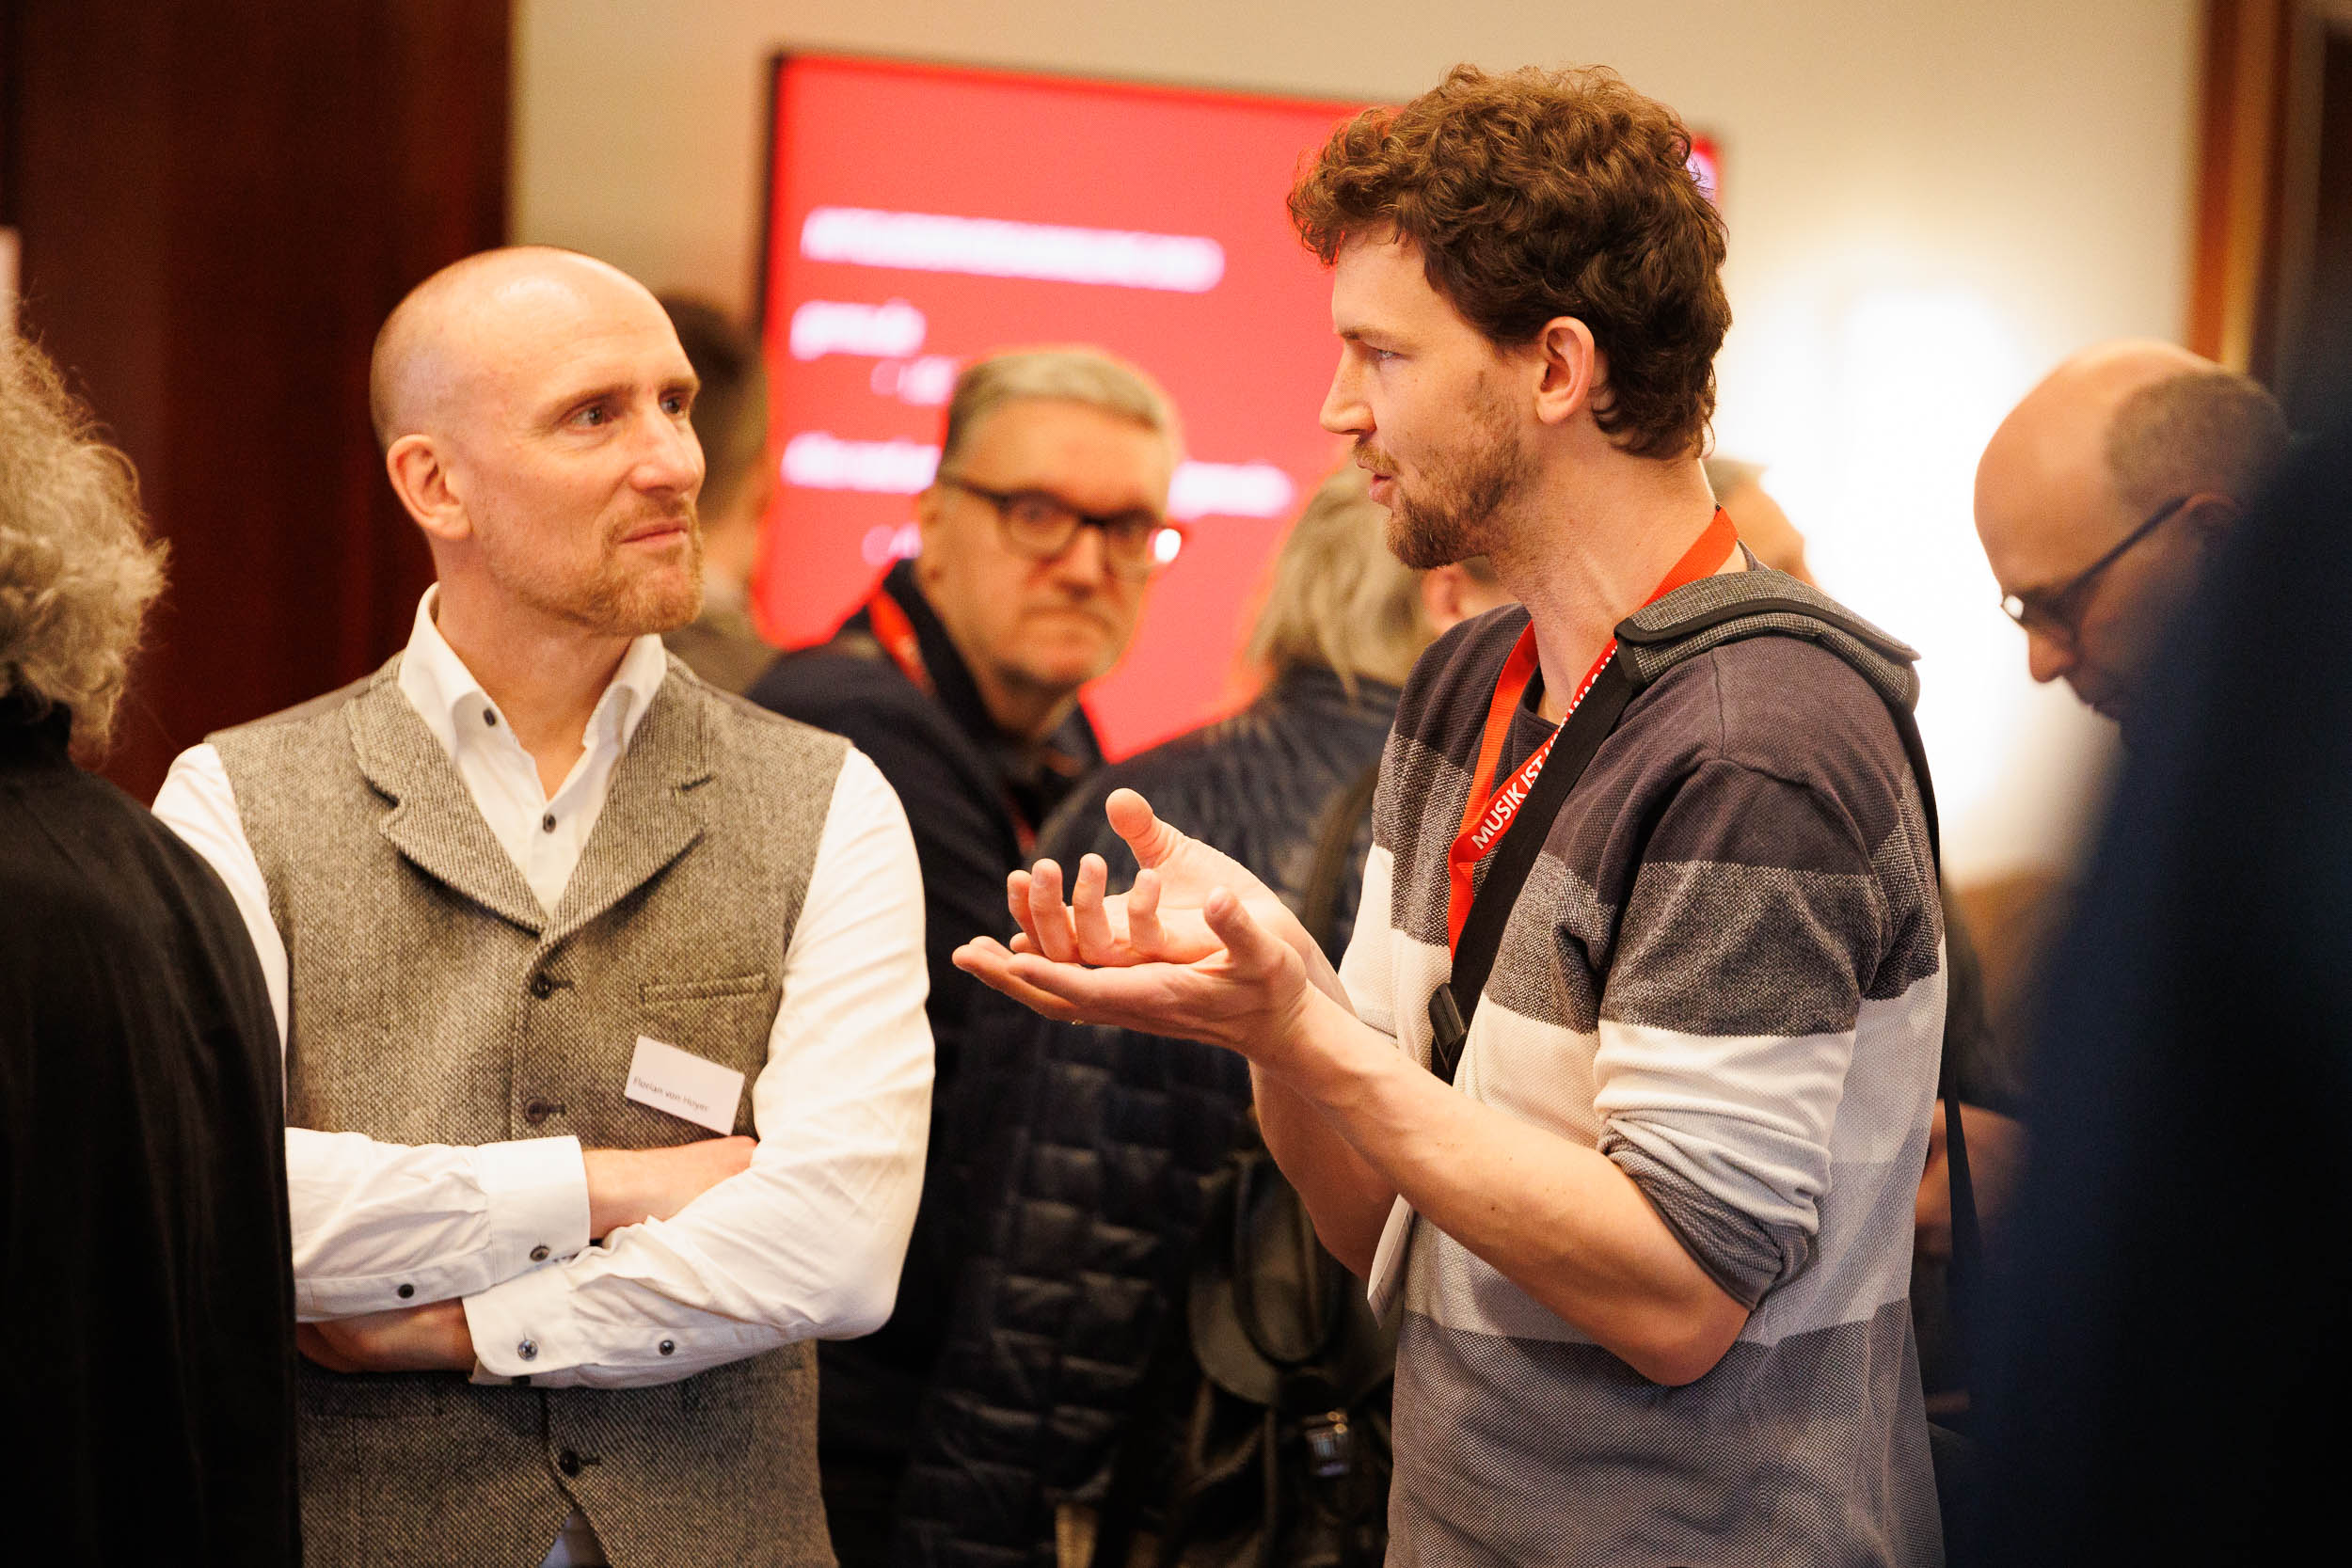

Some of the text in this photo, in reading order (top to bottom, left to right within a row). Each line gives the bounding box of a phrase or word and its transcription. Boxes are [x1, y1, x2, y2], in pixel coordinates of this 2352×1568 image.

[1471, 754, 1543, 849] MUSIK IST
[633, 1076, 663, 1096] Florian
[665, 1090, 681, 1101] von
